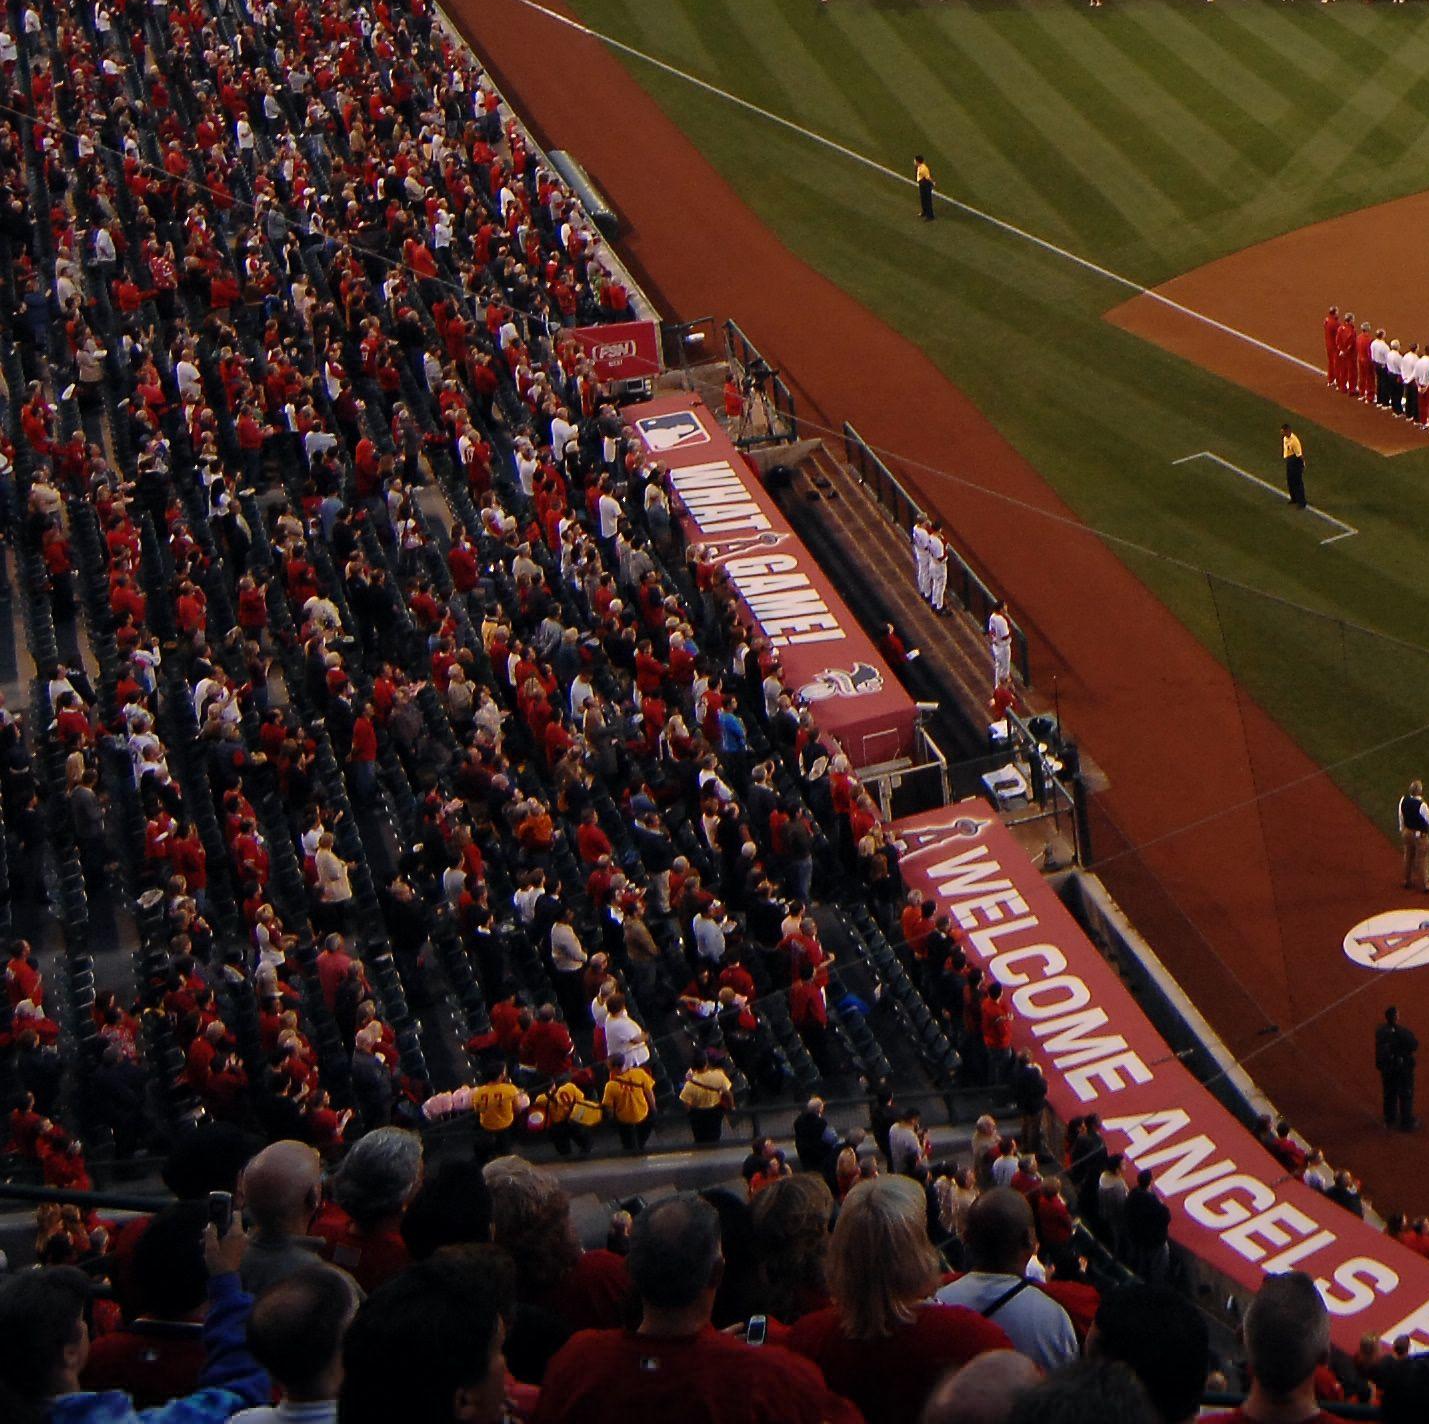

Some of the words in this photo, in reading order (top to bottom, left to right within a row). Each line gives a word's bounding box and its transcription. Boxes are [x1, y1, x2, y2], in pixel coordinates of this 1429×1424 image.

[671, 461, 771, 534] WHAT
[725, 554, 846, 647] GAME!
[927, 846, 1153, 1103] WELCOME
[1102, 1108, 1399, 1316] ANGELS
